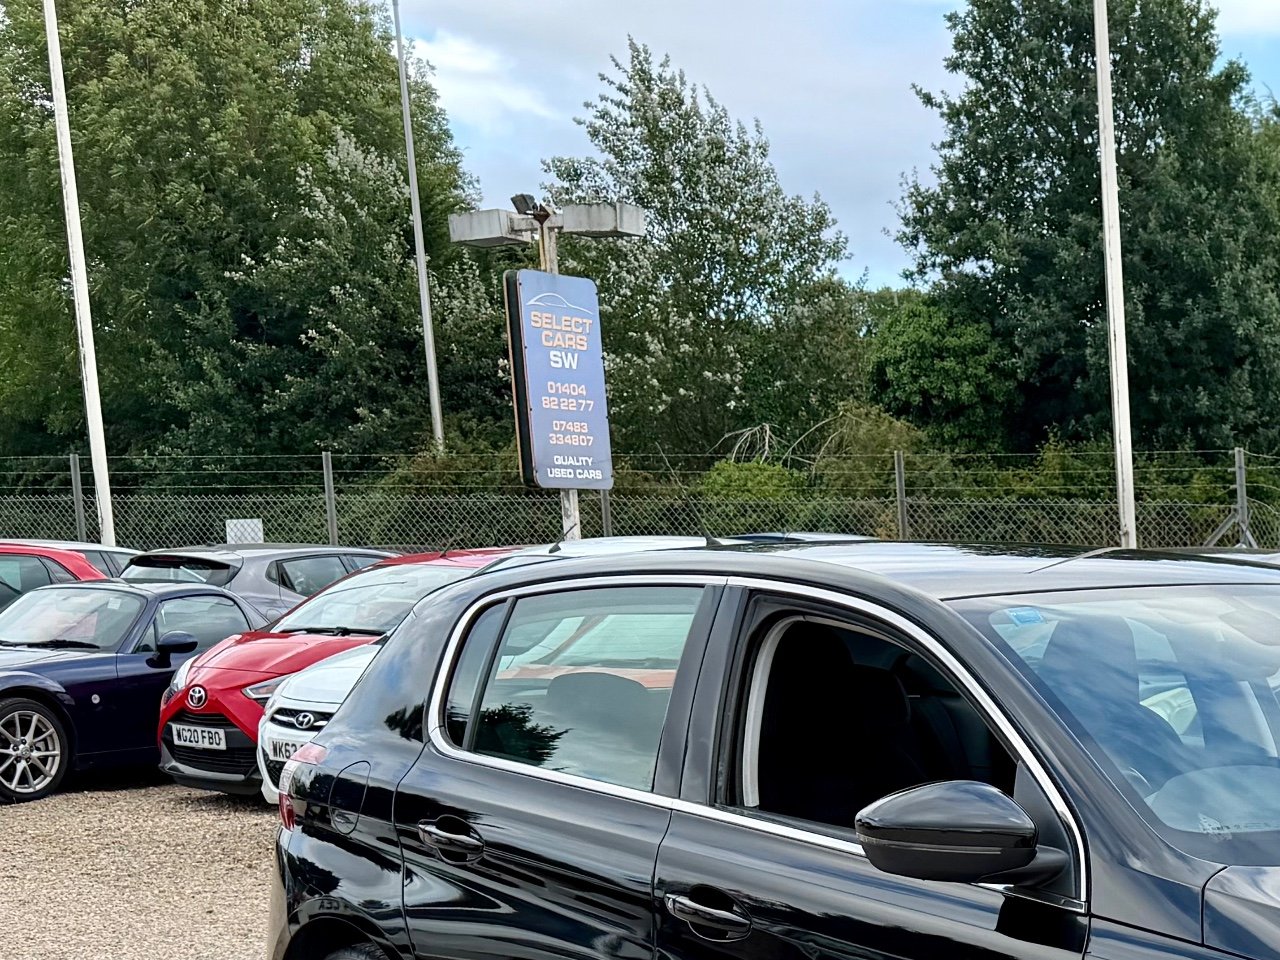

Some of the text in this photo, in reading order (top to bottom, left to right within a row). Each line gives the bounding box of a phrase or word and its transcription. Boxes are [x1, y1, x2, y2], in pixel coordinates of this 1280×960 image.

[530, 311, 593, 334] SELECT
[541, 331, 588, 351] CARS
[549, 350, 578, 370] SW
[547, 381, 587, 396] 01404
[552, 420, 589, 434] 07483
[548, 433, 594, 447] 334807
[553, 454, 593, 467] QUALITY
[546, 467, 603, 480] USED CARS
[175, 727, 199, 744] WG20
